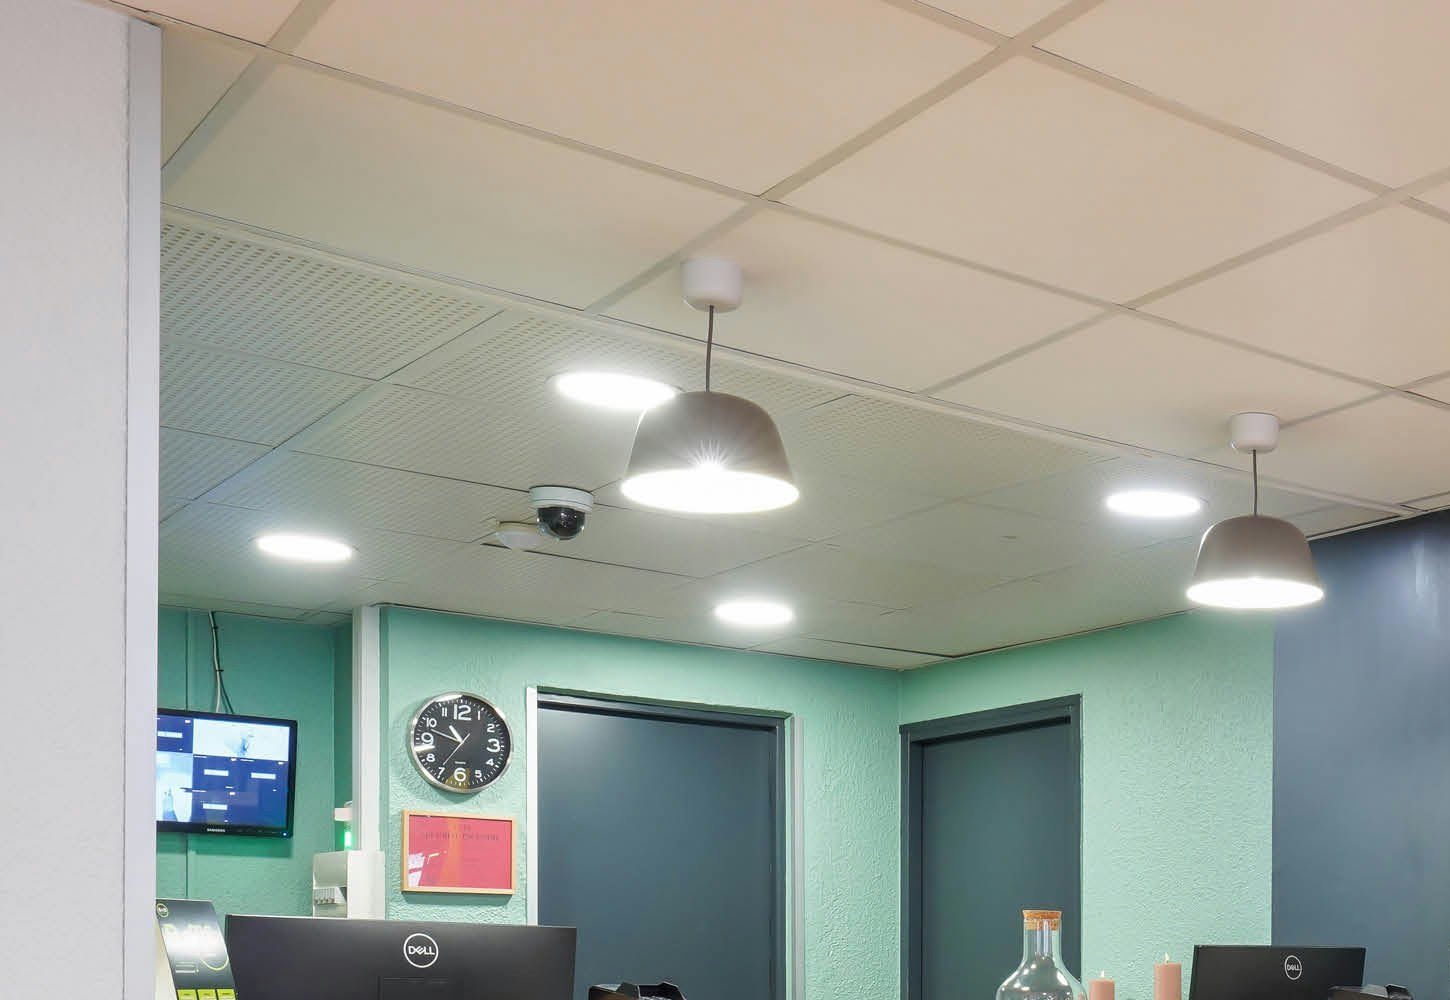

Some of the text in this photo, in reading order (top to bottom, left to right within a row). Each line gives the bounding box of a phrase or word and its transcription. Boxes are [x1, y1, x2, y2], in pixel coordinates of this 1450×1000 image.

[441, 707, 448, 717] 11
[453, 704, 472, 720] 12
[426, 718, 437, 728] 10
[487, 723, 495, 733] 2
[421, 732, 434, 746] 9
[486, 738, 500, 753] 3
[426, 753, 436, 762] 8
[486, 758, 495, 766] 4
[438, 767, 446, 776] 7
[453, 767, 467, 782] 6
[474, 769, 483, 778] 5
[408, 946, 435, 955] DELL
